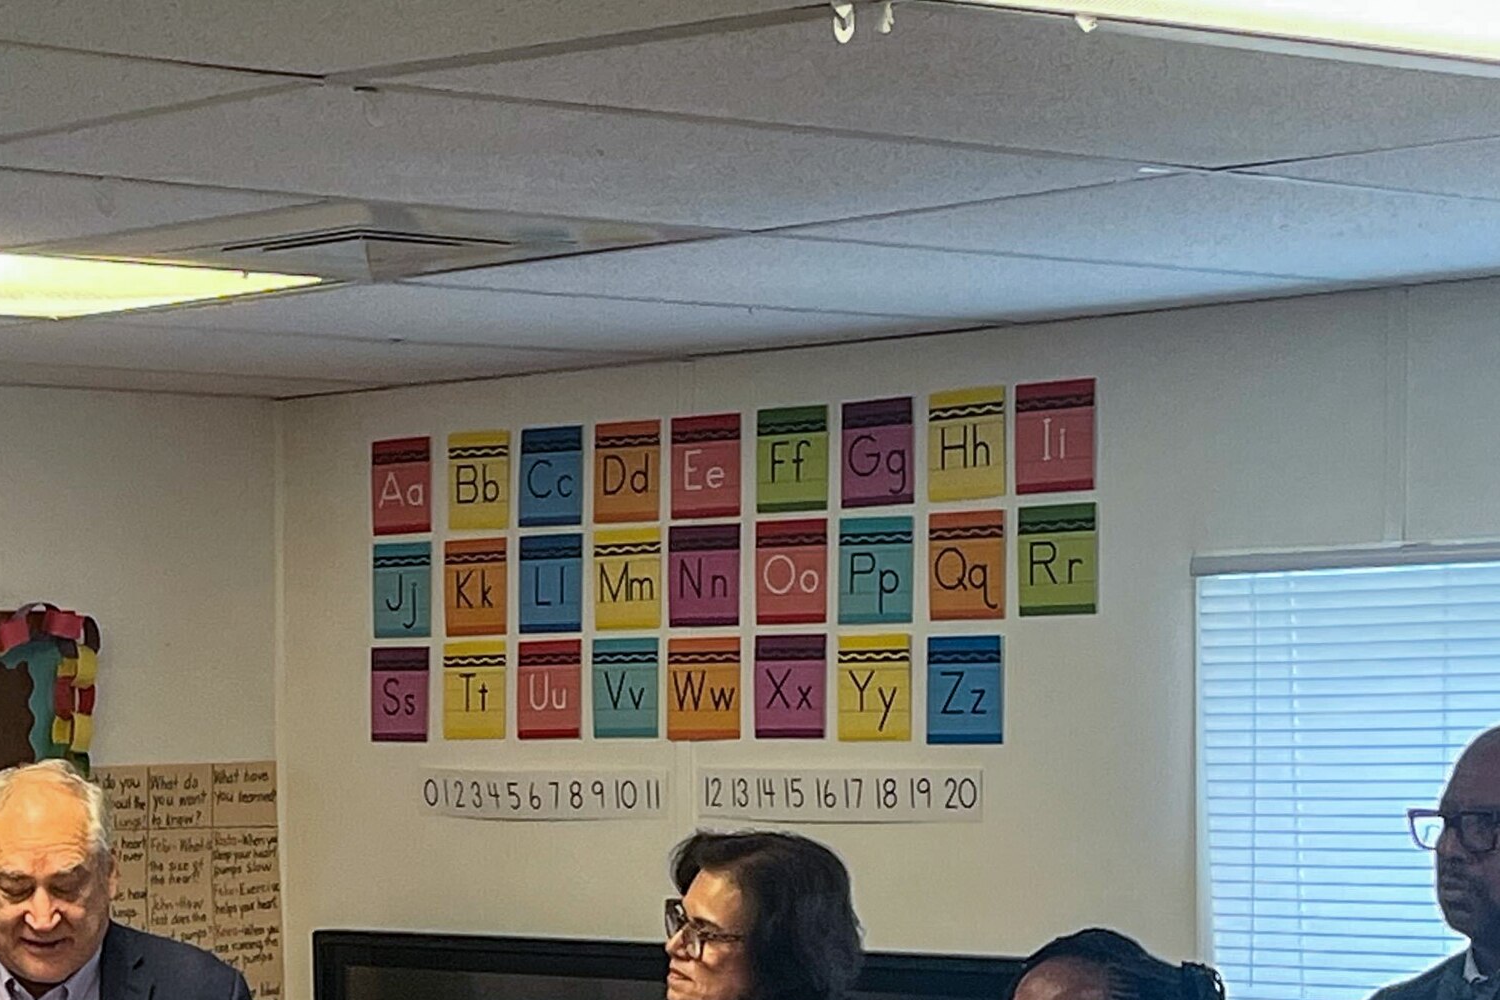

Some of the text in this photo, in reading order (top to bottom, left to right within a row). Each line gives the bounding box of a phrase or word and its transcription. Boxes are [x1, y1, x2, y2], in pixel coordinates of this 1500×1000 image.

[940, 424, 990, 471] Hh
[1042, 418, 1066, 461] Ii
[527, 459, 573, 498] Cc
[603, 453, 649, 495] Dd
[684, 450, 725, 491] Ee
[771, 440, 811, 483] Ff
[848, 435, 906, 493] Gg
[379, 471, 424, 508] Aa
[456, 464, 499, 503] Bb
[600, 562, 654, 603] Mm
[680, 558, 727, 598] Nn
[764, 555, 819, 594] Oo
[850, 552, 899, 614] Pp
[934, 547, 997, 609] Qq
[1029, 541, 1083, 586] Rr
[386, 573, 417, 627] Jj
[456, 570, 493, 609] Kk
[534, 566, 566, 606] Ll
[382, 677, 415, 715] Ss
[459, 673, 488, 711] Tt
[529, 672, 567, 710] Uu
[604, 671, 644, 710] Vv
[673, 670, 735, 711] Ww
[766, 668, 812, 710] Xx
[849, 670, 897, 731] Yy
[940, 671, 986, 715] Zz
[150, 773, 199, 790] What do
[152, 790, 207, 813] you want
[214, 791, 233, 806] you
[705, 777, 977, 809] 12 13 14 15 16 17 18 19 20
[166, 810, 202, 826] know?
